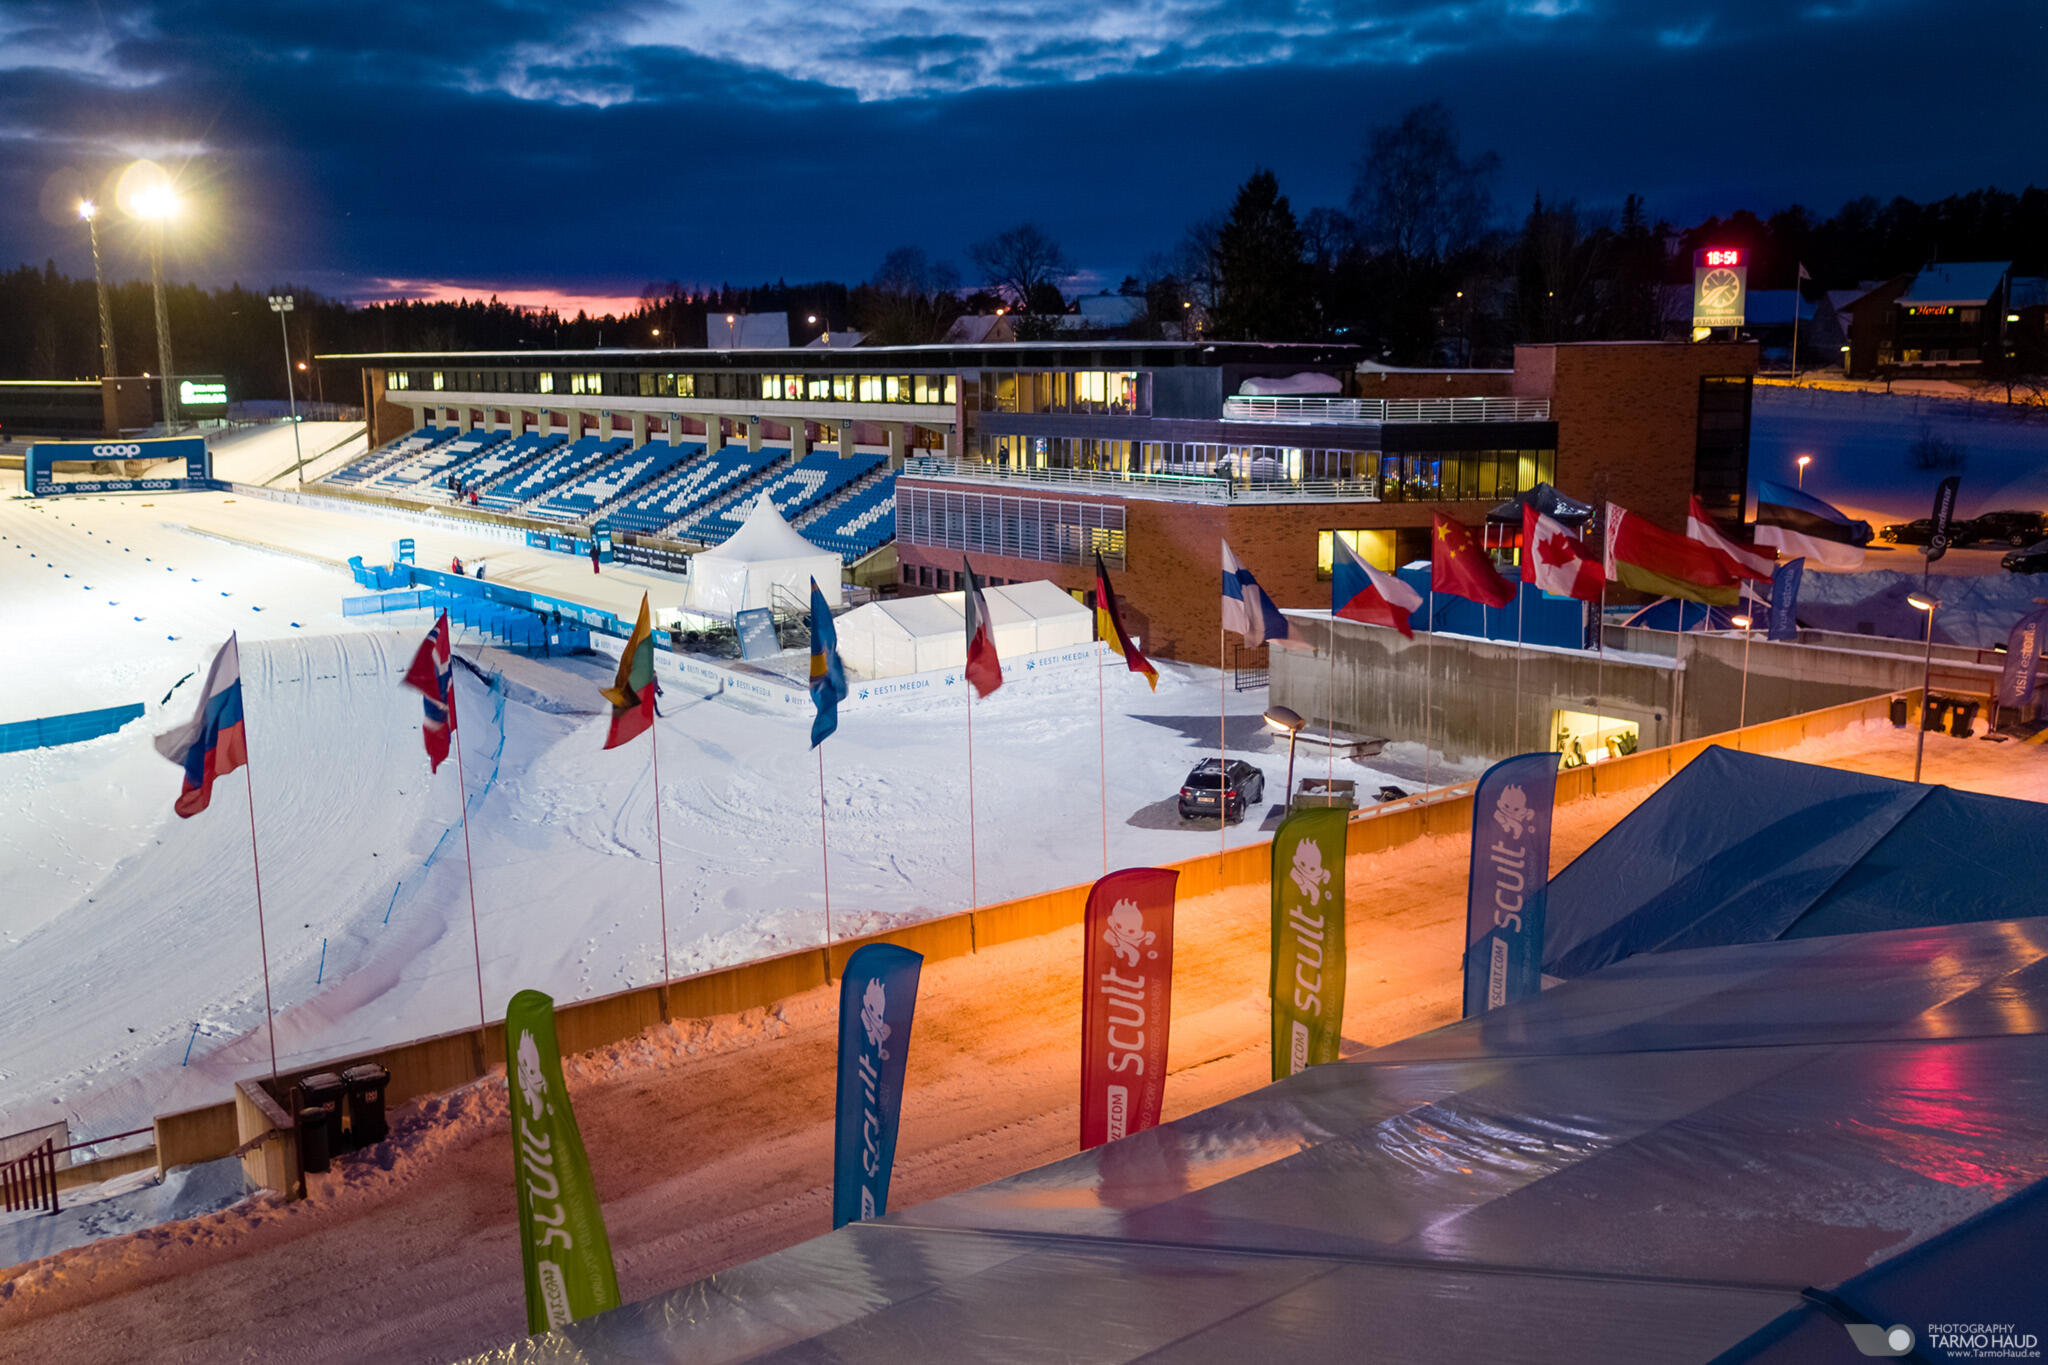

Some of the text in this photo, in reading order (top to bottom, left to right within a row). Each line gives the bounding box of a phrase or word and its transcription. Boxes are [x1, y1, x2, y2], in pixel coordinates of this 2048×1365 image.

[93, 444, 141, 458] coop
[36, 484, 67, 494] coop
[75, 483, 101, 491] coop
[107, 481, 133, 490] coop
[141, 480, 172, 490] coop
[1039, 651, 1090, 667] EESTI MEEDIA
[2015, 622, 2037, 697] visit estonia
[874, 680, 930, 696] EESTI MEEDIA
[1490, 841, 1526, 933] scult
[1289, 905, 1325, 1017] scult
[1101, 967, 1146, 1076] scult
[1144, 1083, 1157, 1111] SPORT
[1151, 977, 1162, 1025] MOVEMENT
